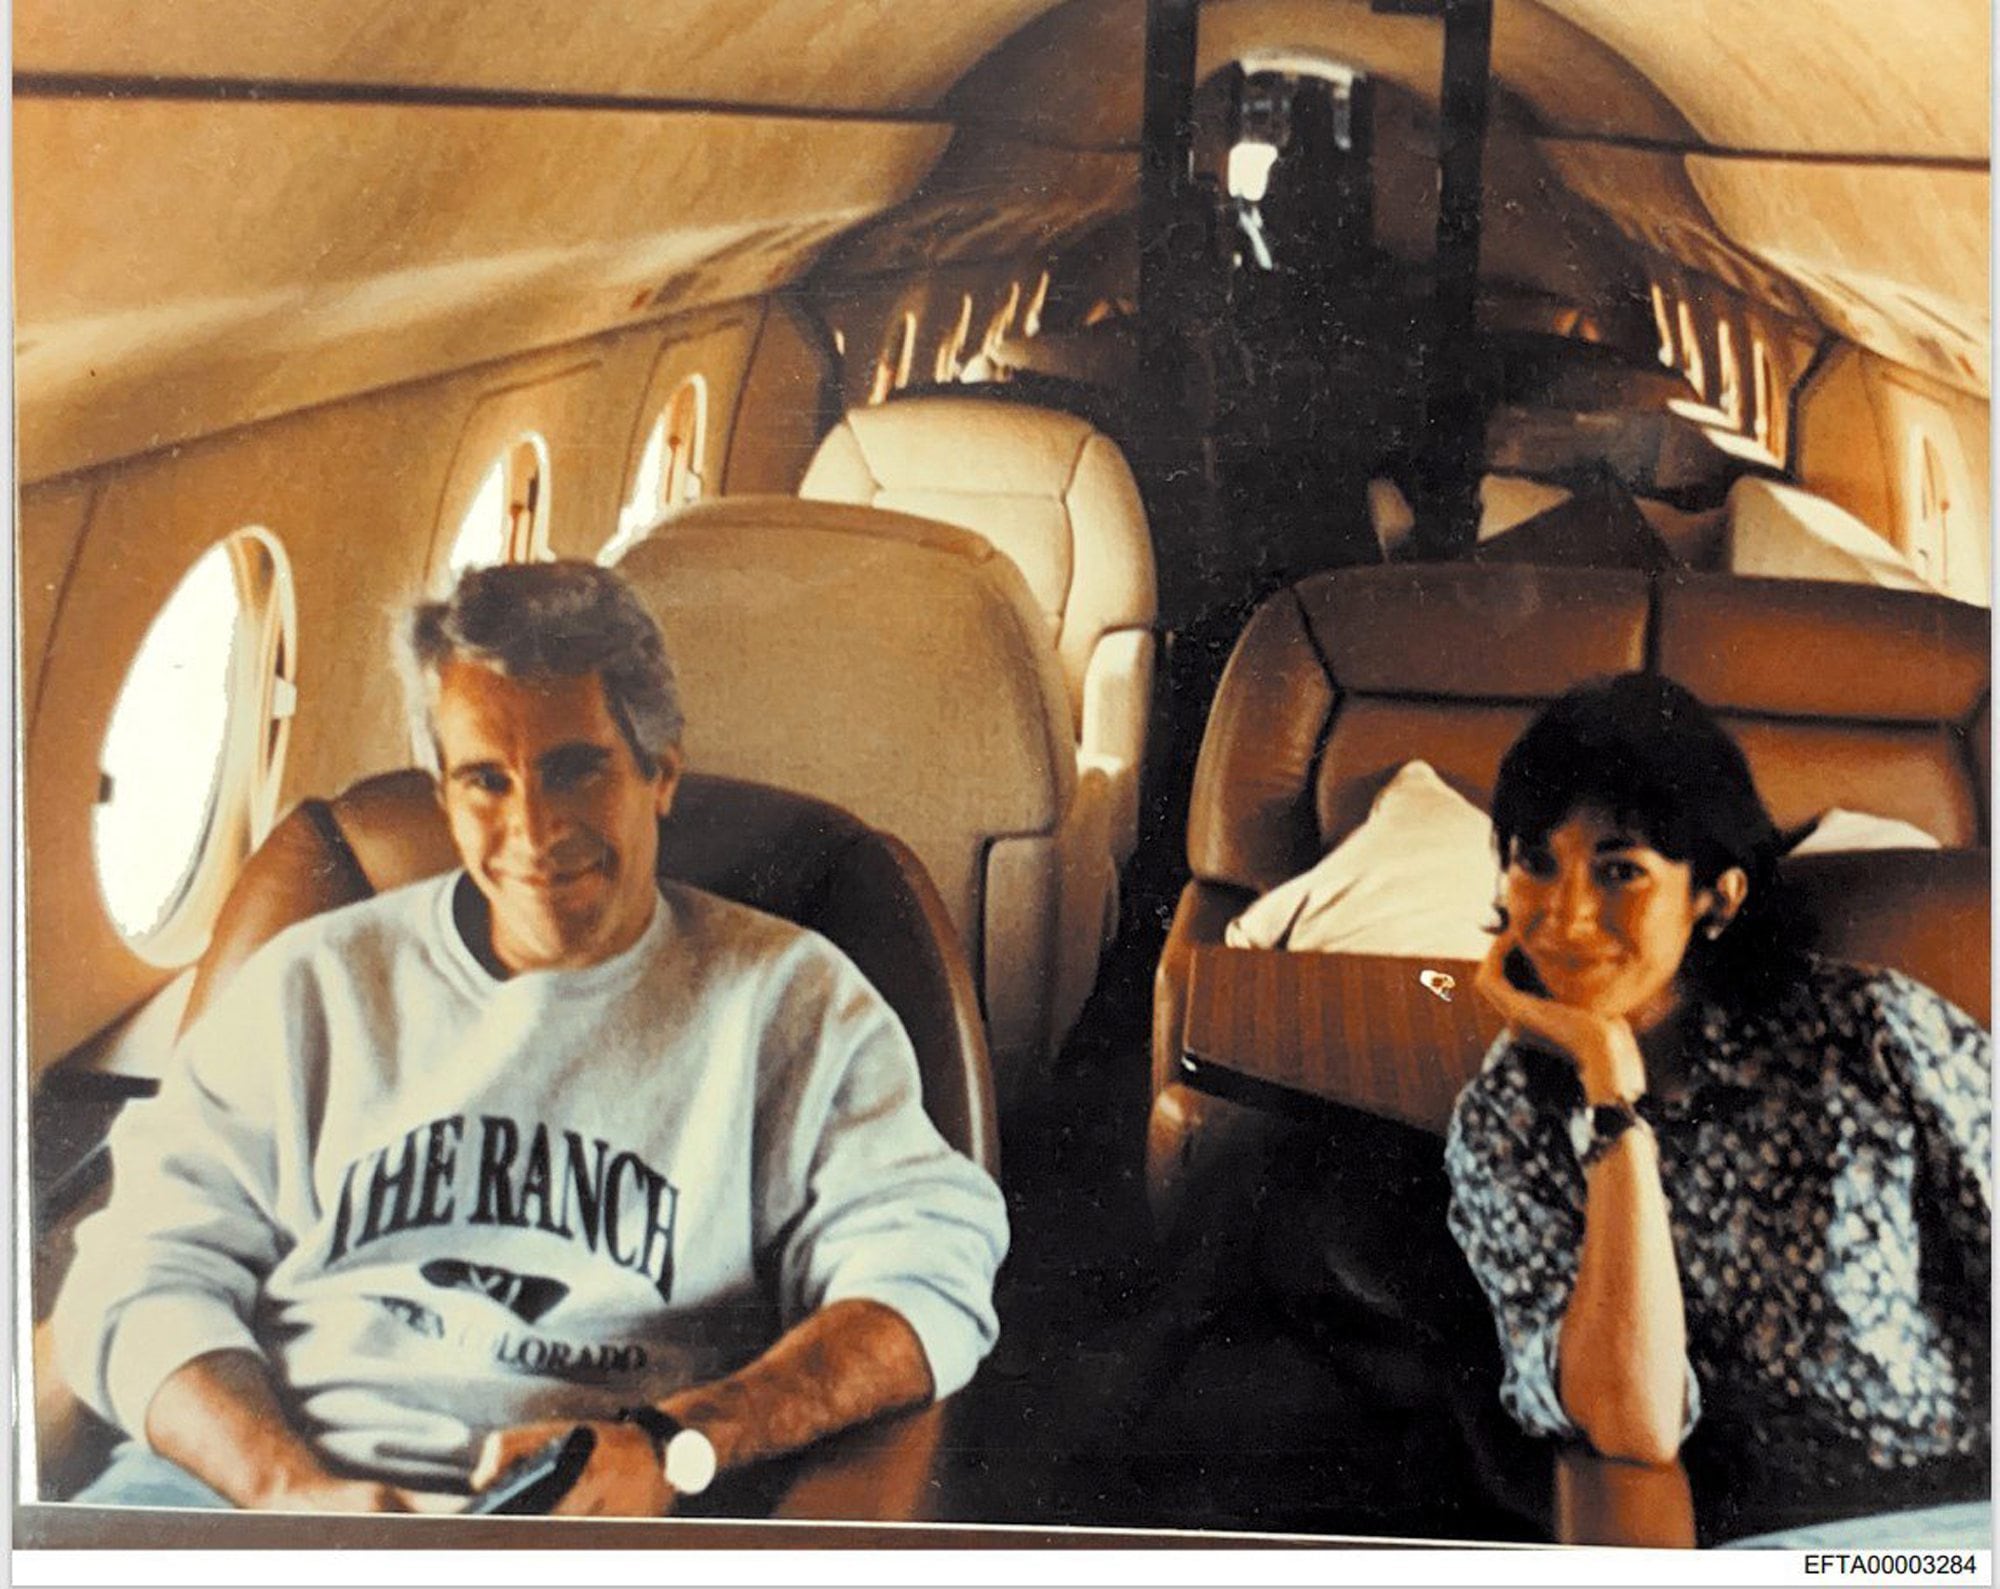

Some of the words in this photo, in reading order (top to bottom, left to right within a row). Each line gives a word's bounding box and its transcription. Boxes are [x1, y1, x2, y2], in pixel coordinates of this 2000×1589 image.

[323, 1113, 465, 1267] THE
[467, 1113, 680, 1306] RANCH
[458, 1324, 649, 1374] LORADO
